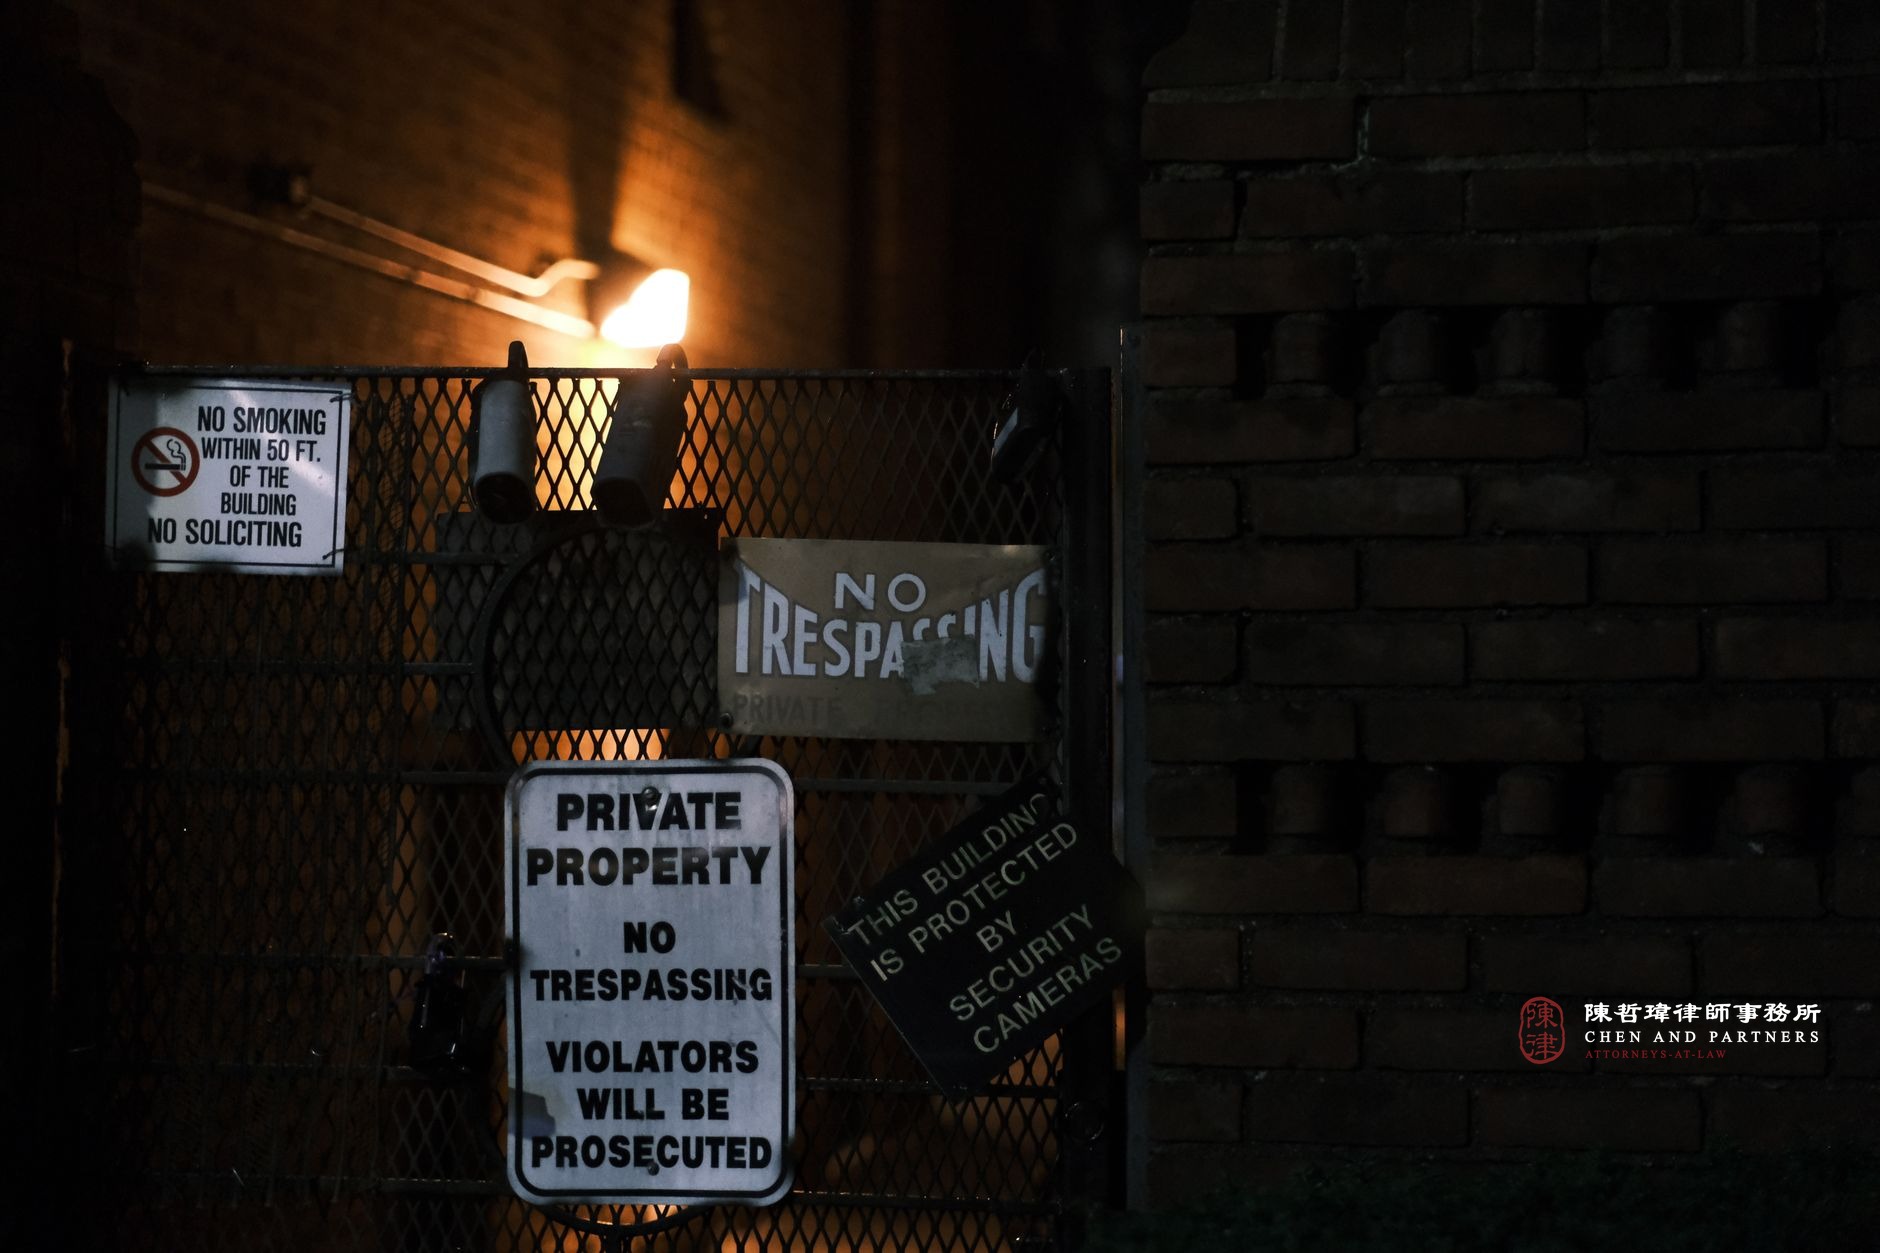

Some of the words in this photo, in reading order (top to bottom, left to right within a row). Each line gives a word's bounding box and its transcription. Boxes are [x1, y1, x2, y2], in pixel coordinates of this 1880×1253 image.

[198, 406, 225, 432] NO
[233, 406, 326, 435] SMOKING
[201, 437, 261, 461] WITHIN
[267, 439, 289, 461] 50
[296, 440, 321, 462] FT.
[230, 465, 251, 487] OF
[258, 466, 289, 488] THE
[221, 492, 296, 516] BUILDING
[148, 518, 176, 544] NO
[185, 519, 302, 547] SOLICITING
[834, 572, 927, 613] NO
[557, 791, 742, 831] PRIVATE
[527, 846, 771, 886] PROPERTY
[848, 889, 919, 946] THIS
[870, 948, 905, 983] IS
[907, 822, 1078, 955] PROTECTED
[624, 921, 676, 953] NO
[975, 909, 1017, 953] BY
[949, 903, 1094, 1021] SECURITY
[530, 968, 772, 1001] TRESPASSING
[973, 936, 1122, 1053] CAMERAS
[546, 1040, 759, 1073] VIOLATORS
[577, 1088, 665, 1120] WILL
[682, 1088, 729, 1120] BE
[531, 1135, 772, 1168] PROSECUTED
